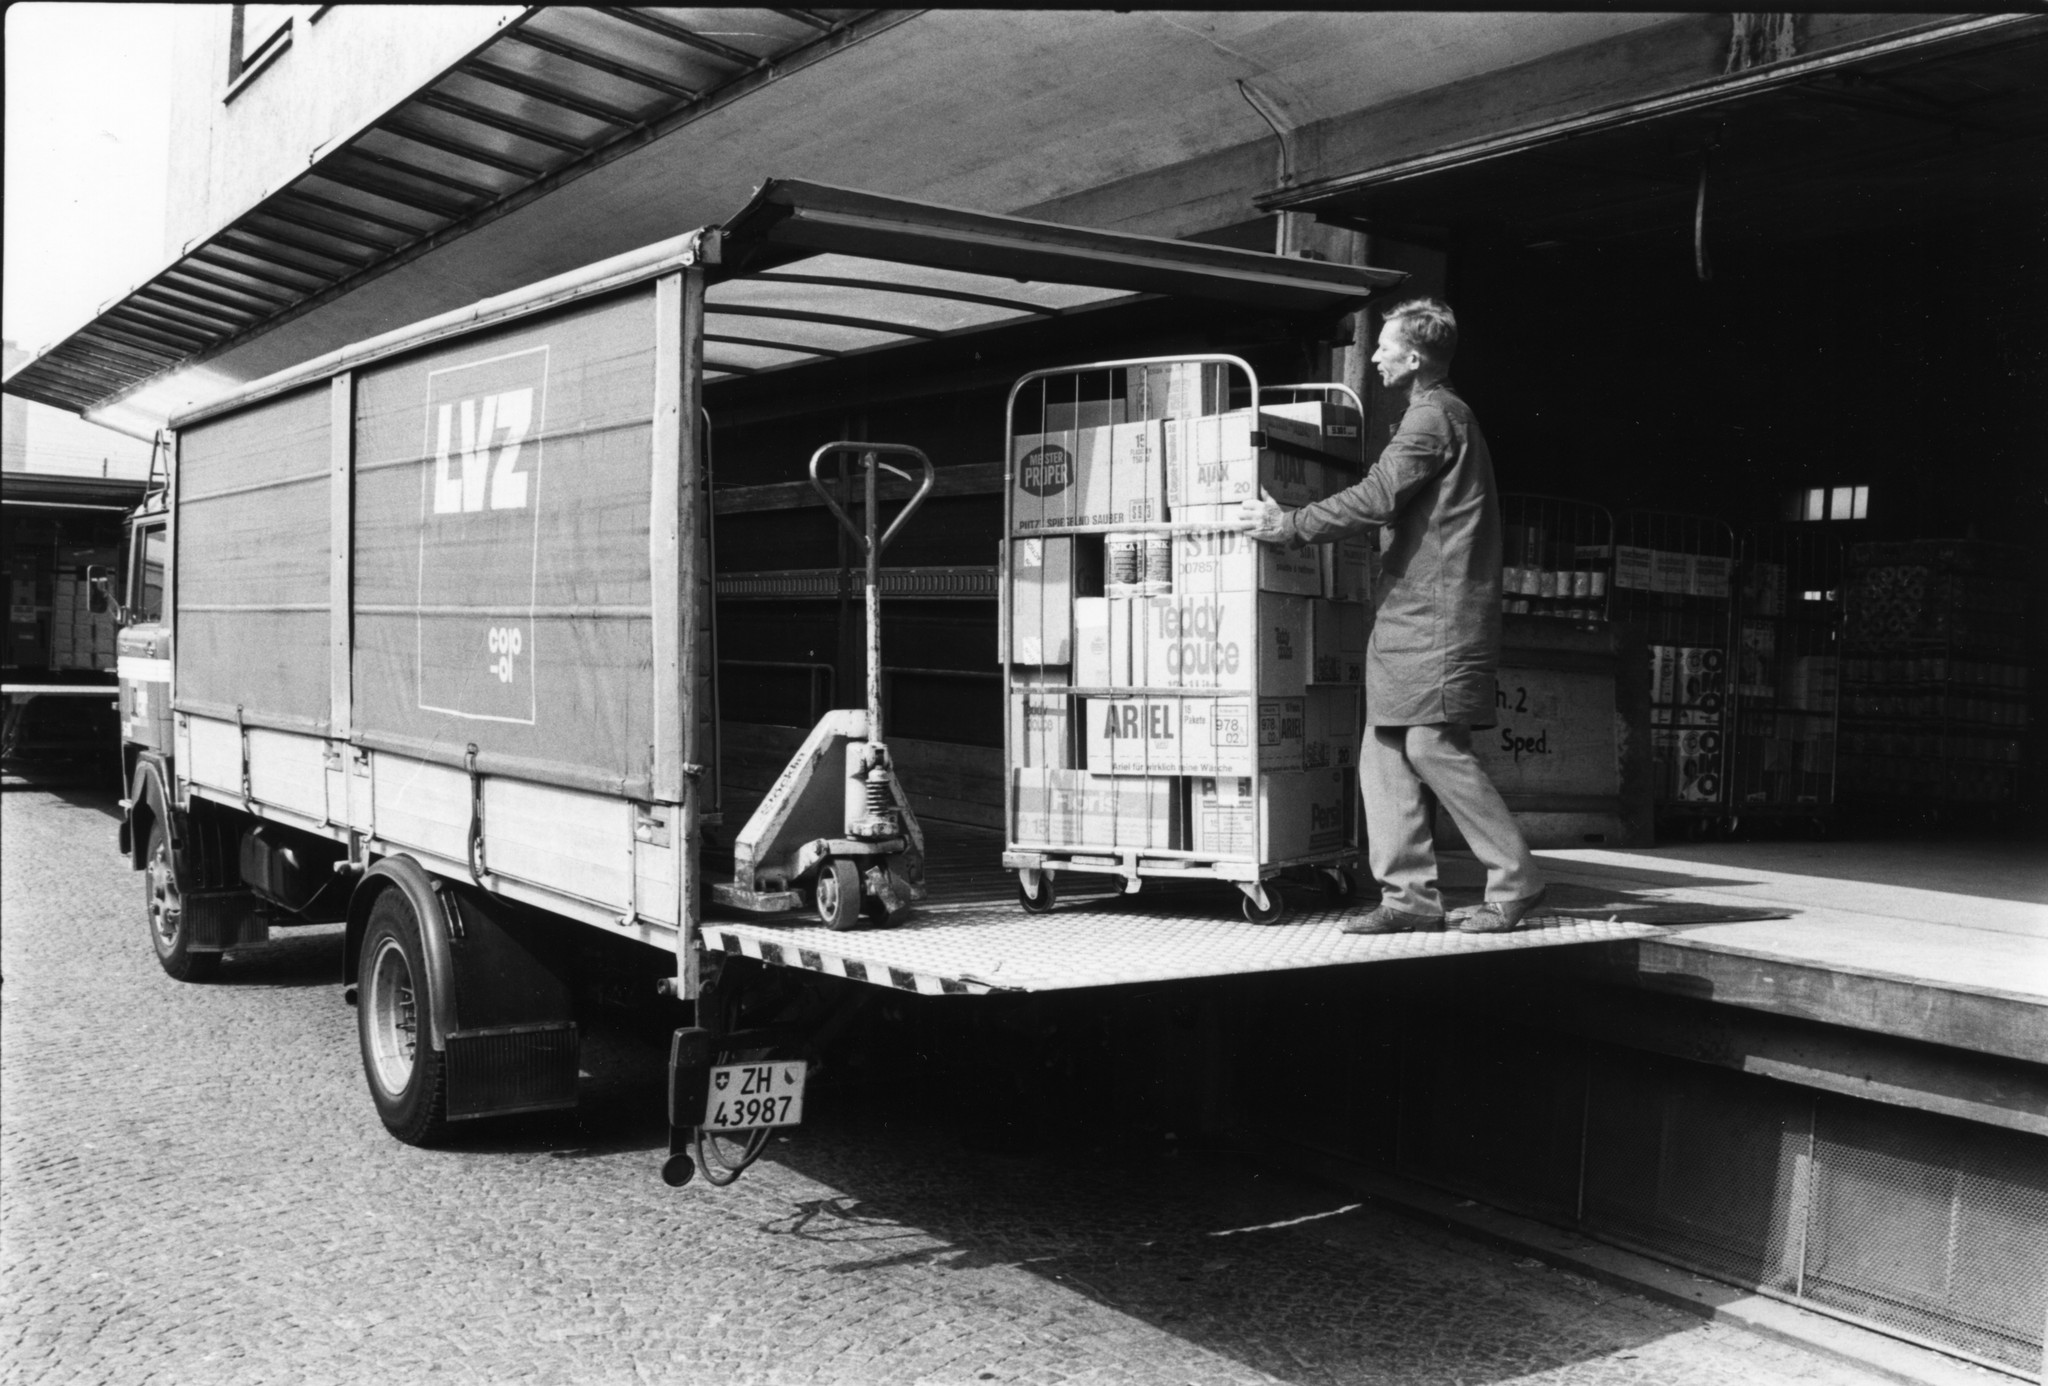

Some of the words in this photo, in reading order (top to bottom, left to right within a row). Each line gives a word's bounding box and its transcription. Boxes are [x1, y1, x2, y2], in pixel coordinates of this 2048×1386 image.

[434, 388, 533, 514] LVZ
[1029, 451, 1063, 466] MESTER
[1025, 464, 1067, 487] PROPER
[1234, 482, 1251, 494] 20
[1019, 519, 1044, 530] PUTZ
[1151, 596, 1225, 642] Teddy
[1103, 704, 1174, 739] ARIEL
[1216, 718, 1239, 731] 978
[1226, 733, 1239, 744] 02
[1500, 727, 1552, 763] Sped.
[740, 1066, 772, 1095] ZH
[714, 1096, 793, 1127] 43987
